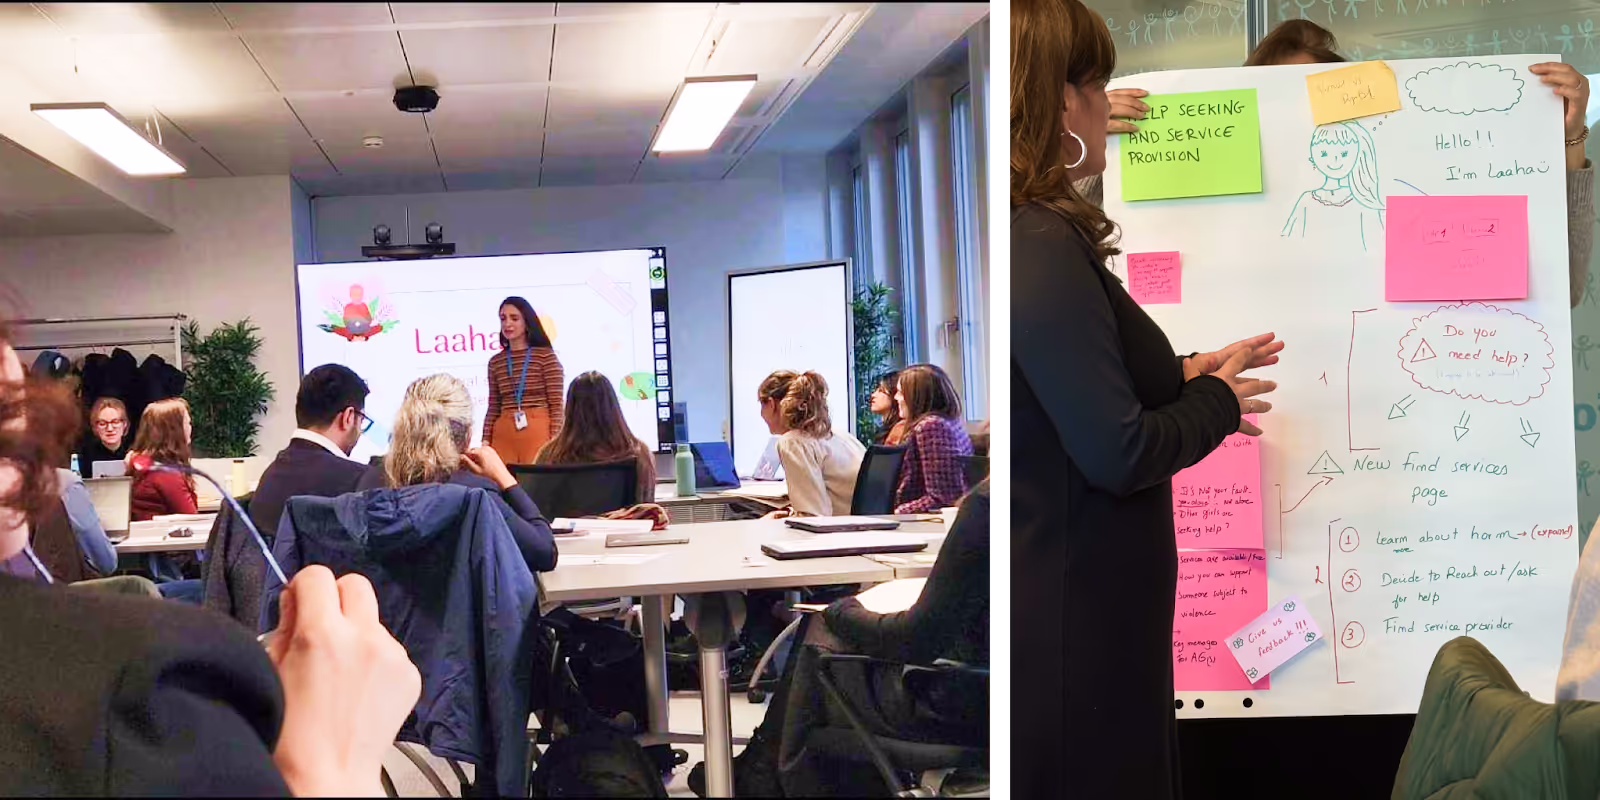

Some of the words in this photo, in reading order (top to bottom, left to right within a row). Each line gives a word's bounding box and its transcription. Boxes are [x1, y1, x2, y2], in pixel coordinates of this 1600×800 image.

[1128, 105, 1169, 121] LP
[1179, 100, 1245, 117] SEEKING
[1129, 130, 1160, 144] AND
[1166, 125, 1235, 142] SERVICE
[1127, 147, 1200, 165] PROVISION
[1445, 165, 1477, 180] I'm
[1488, 159, 1535, 178] Laaha
[415, 324, 504, 354] Laaha
[1443, 324, 1464, 336] Do
[1473, 328, 1497, 344] you
[1449, 349, 1482, 361] need
[1354, 455, 1391, 471] New
[1451, 461, 1508, 477] services
[1411, 486, 1448, 506] page
[1419, 527, 1459, 542] about
[1381, 570, 1425, 587] Decide
[1428, 571, 1441, 583] to
[1446, 566, 1479, 580] Reach
[1483, 563, 1506, 577] out
[1392, 593, 1408, 609] for
[1418, 592, 1440, 606] help
[1248, 628, 1266, 644] Give
[1272, 617, 1282, 627] us
[1383, 616, 1415, 634] Find
[1424, 618, 1461, 632] service
[1465, 616, 1514, 636] provider
